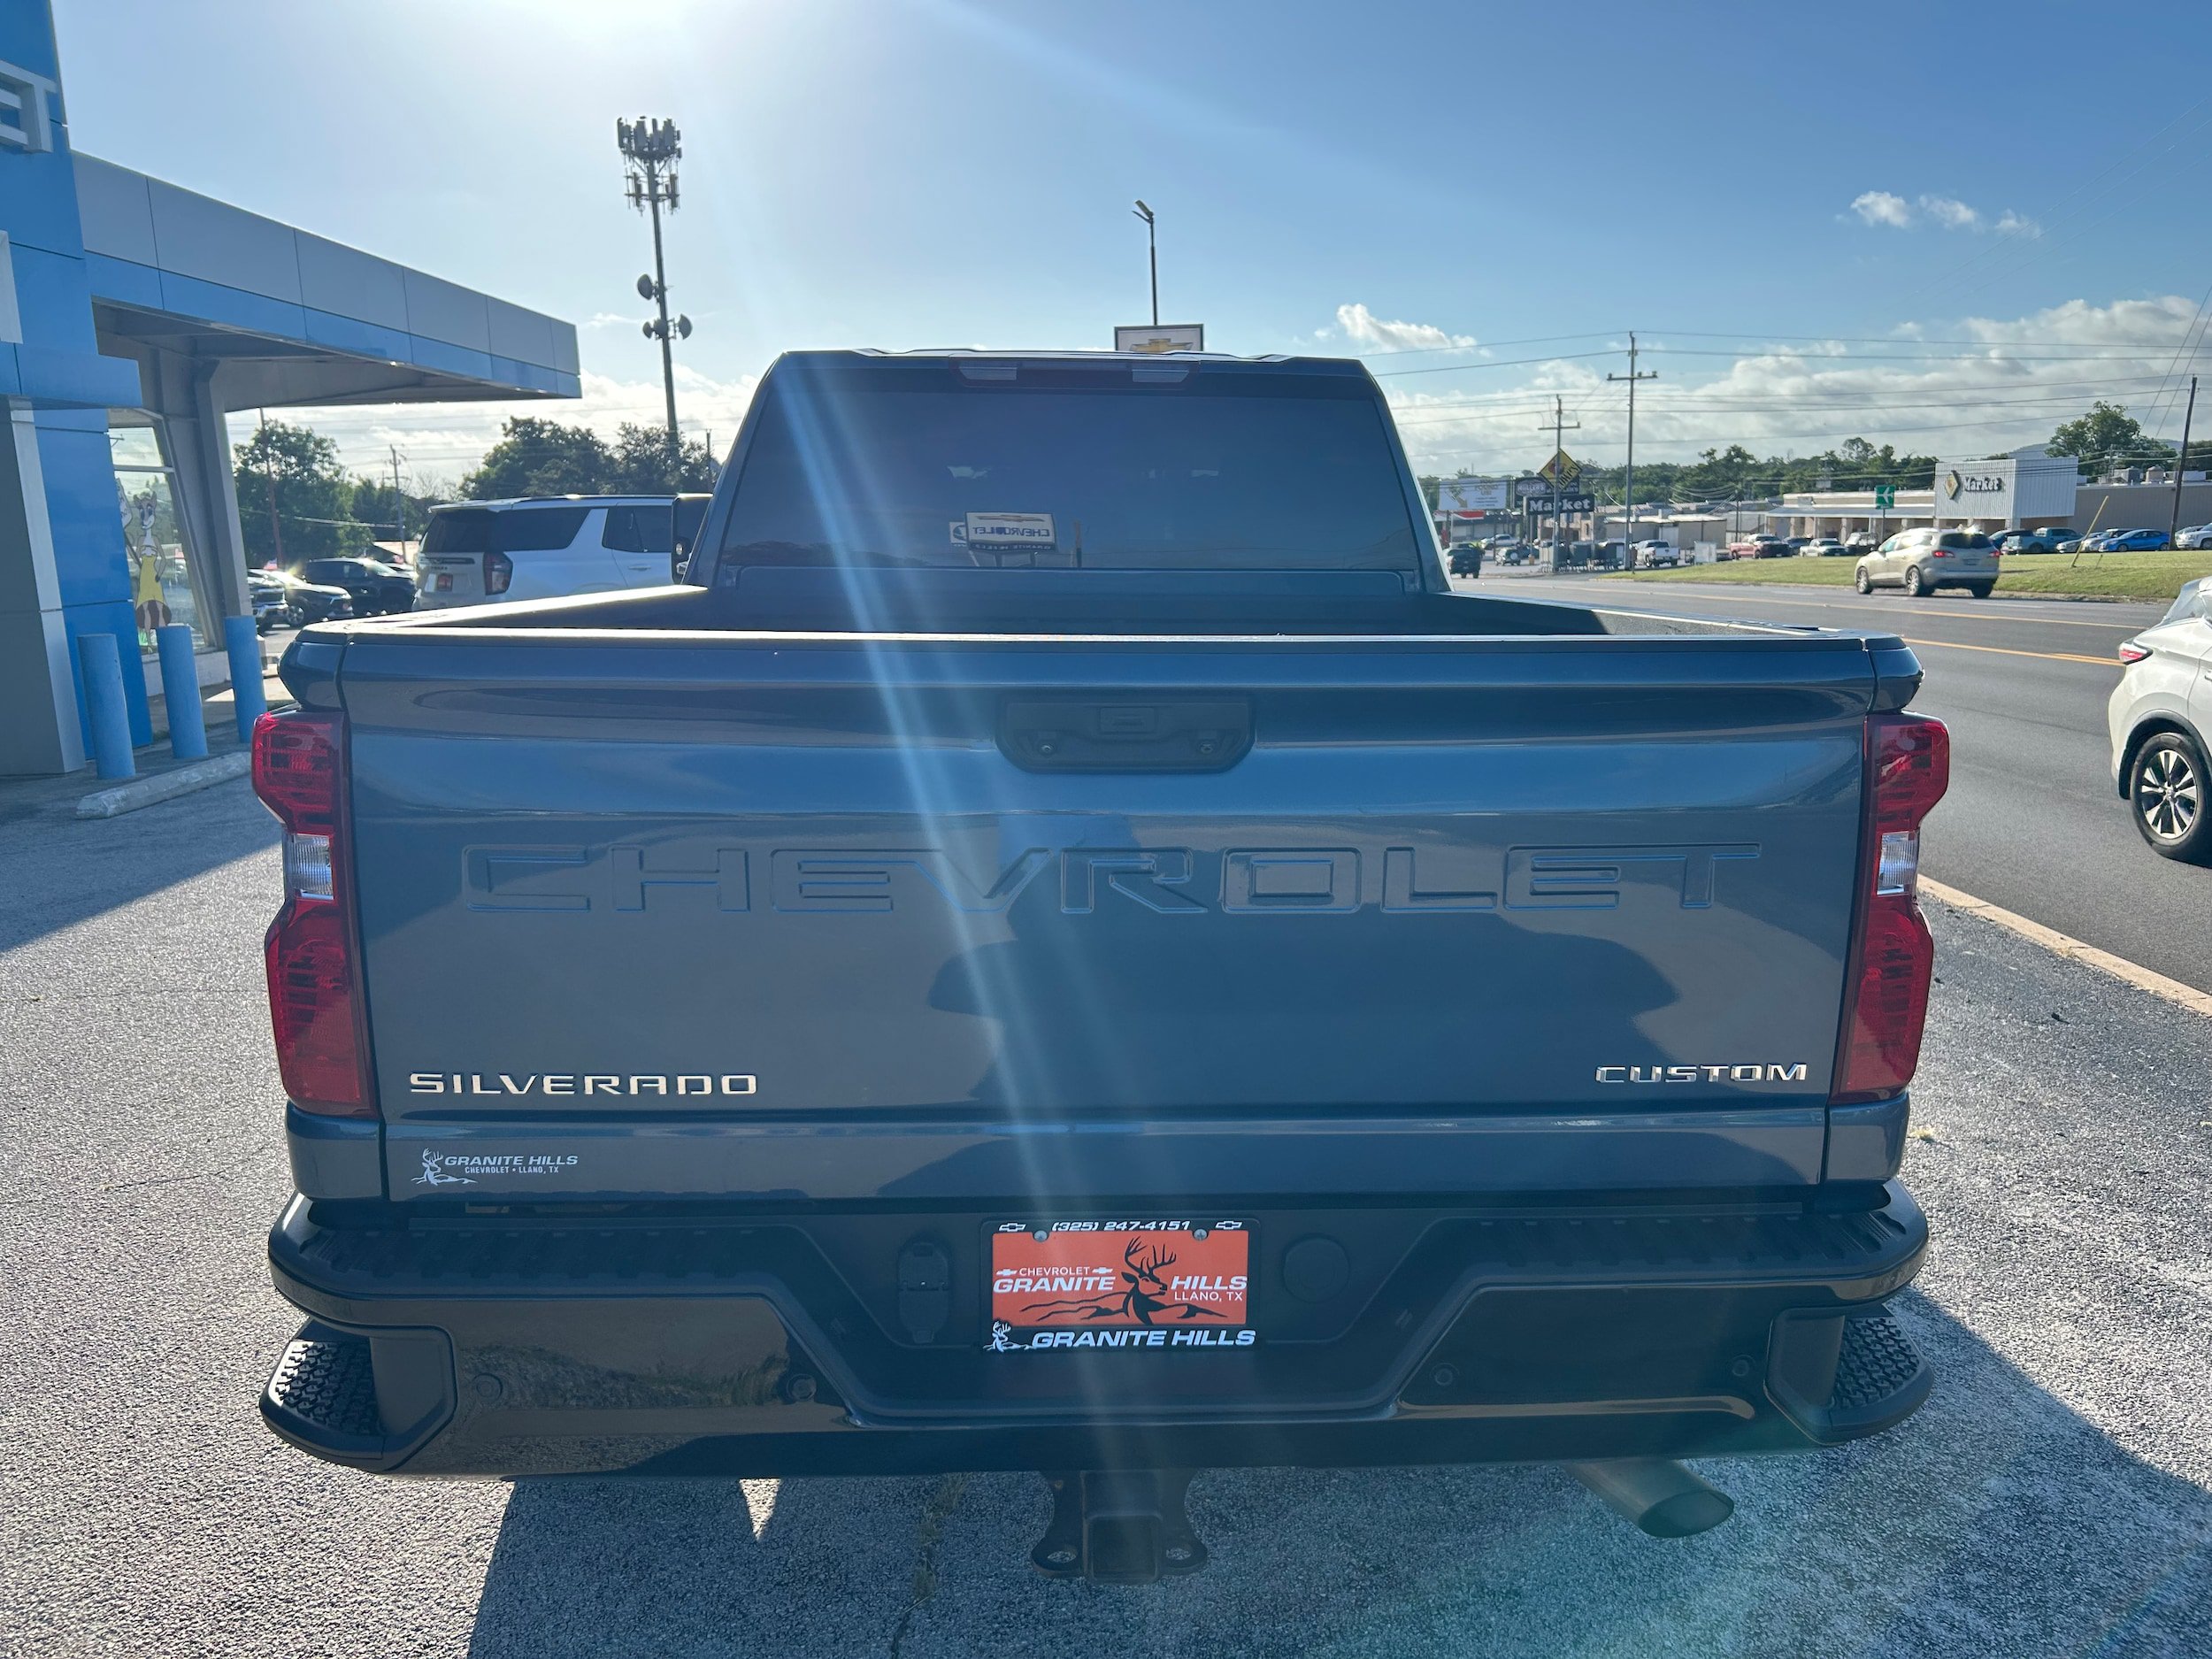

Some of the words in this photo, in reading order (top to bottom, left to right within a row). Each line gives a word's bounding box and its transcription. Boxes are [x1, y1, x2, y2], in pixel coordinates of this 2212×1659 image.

[1963, 476, 2001, 491] Market
[463, 842, 1761, 915] CHEVROLET
[1595, 1063, 1808, 1084] CUSTOM
[409, 1072, 758, 1096] SILVERADO
[444, 1155, 524, 1166] GRANITE
[528, 1155, 579, 1165] HILLS
[465, 1165, 510, 1174] CHEVROLET
[1051, 1221, 1099, 1233] (325)
[1103, 1220, 1191, 1232] 247-4151
[1018, 1266, 1091, 1277] CHEVROLET
[992, 1276, 1117, 1294] GRANITE
[1170, 1275, 1248, 1291] HILLS
[1173, 1291, 1223, 1302] LLANO,
[1226, 1291, 1243, 1302] TX
[1032, 1330, 1165, 1348] GRANITE
[1171, 1329, 1256, 1347] HILLS
